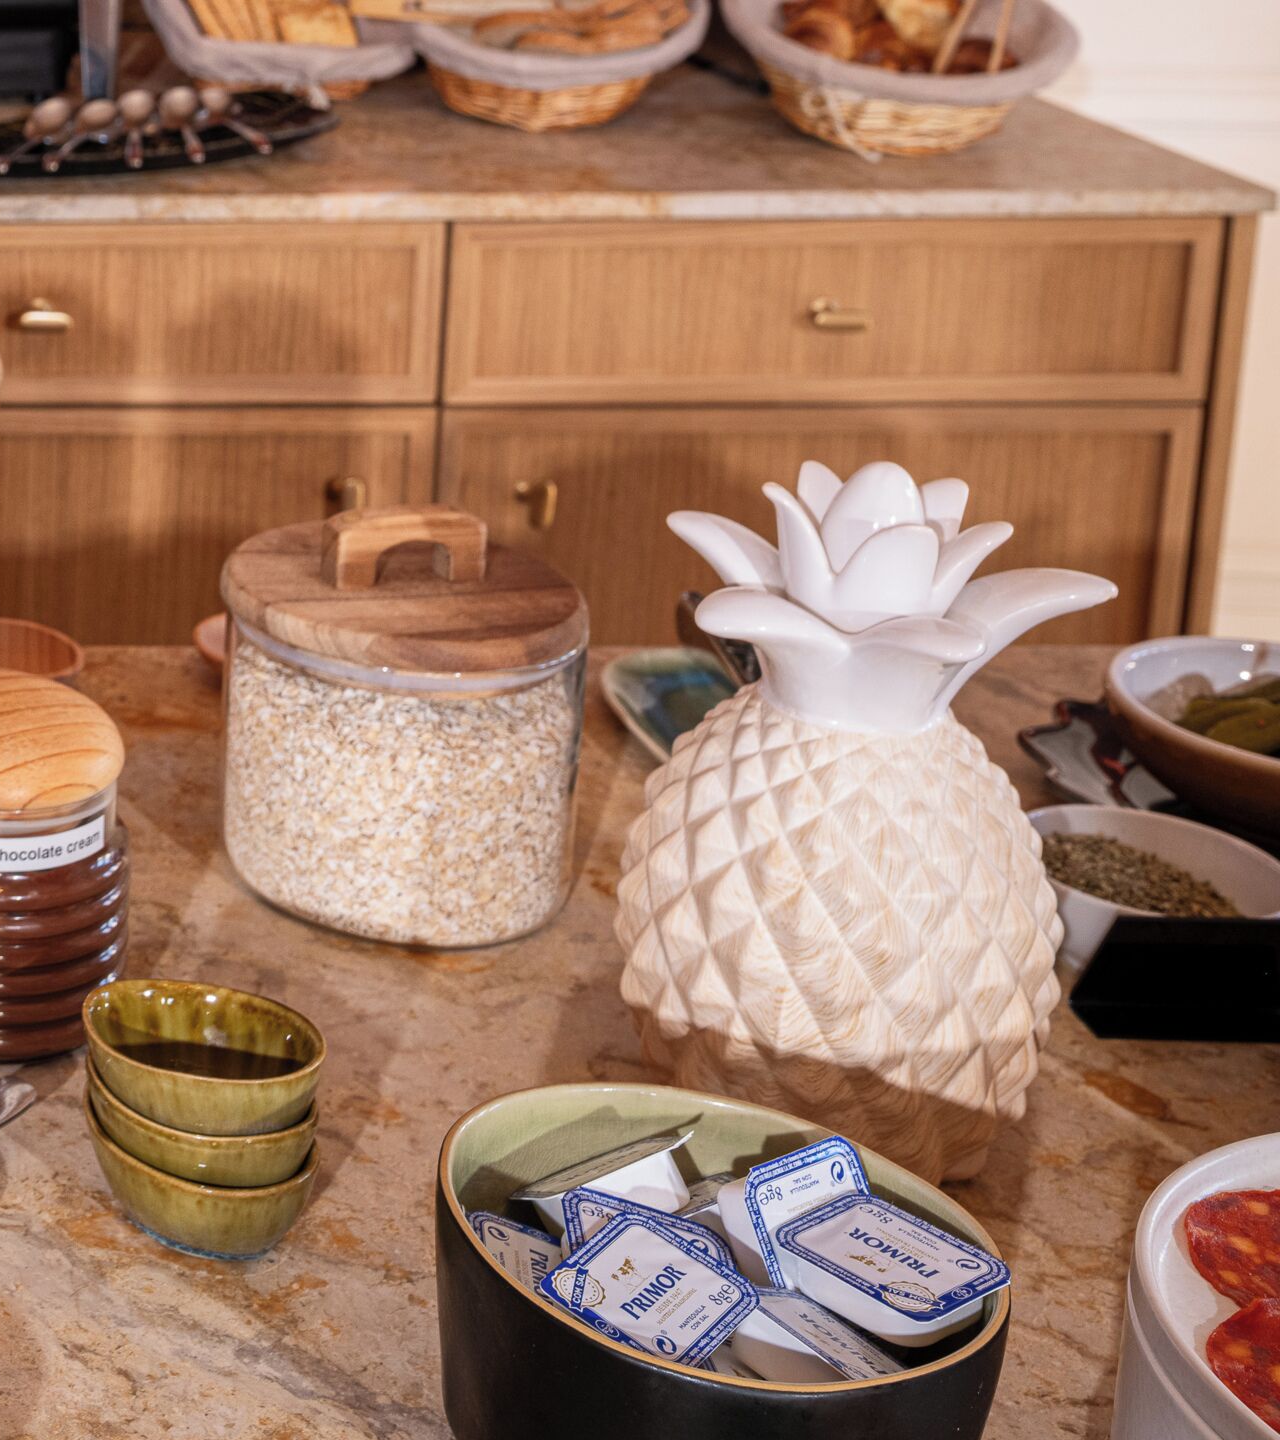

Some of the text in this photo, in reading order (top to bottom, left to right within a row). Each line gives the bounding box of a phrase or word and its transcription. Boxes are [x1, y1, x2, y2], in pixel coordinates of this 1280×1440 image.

[67, 831, 100, 854] cream
[848, 1227, 941, 1279] PRIMOR
[572, 1274, 586, 1304] COM SAL
[620, 1264, 688, 1320] PRIMOR
